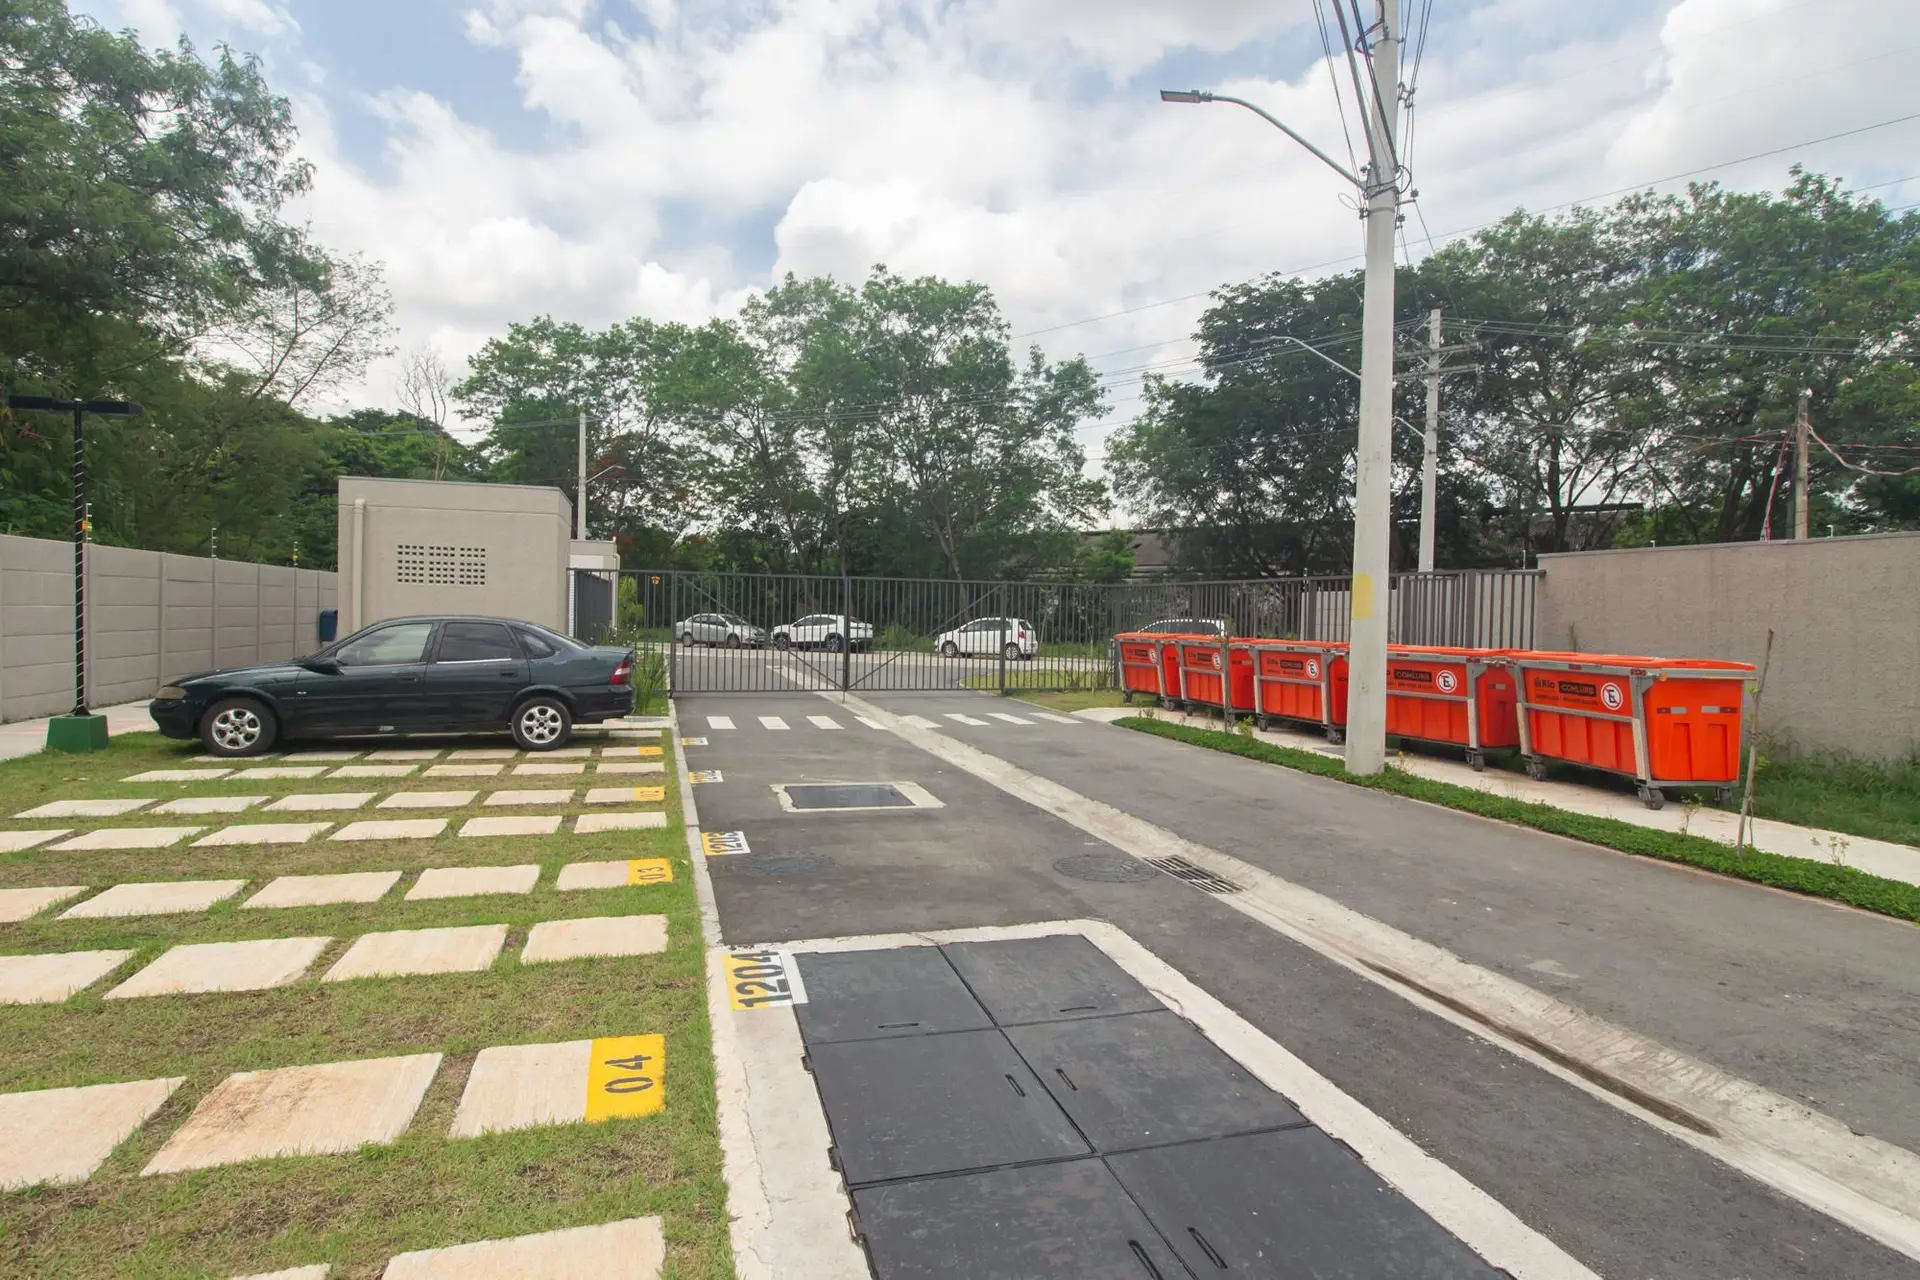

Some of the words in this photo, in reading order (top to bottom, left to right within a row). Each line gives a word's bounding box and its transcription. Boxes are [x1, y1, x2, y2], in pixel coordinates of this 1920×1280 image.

[706, 831, 745, 854] 1203
[637, 866, 666, 881] 03
[731, 949, 793, 1008] 1204
[604, 1054, 654, 1094] 04
